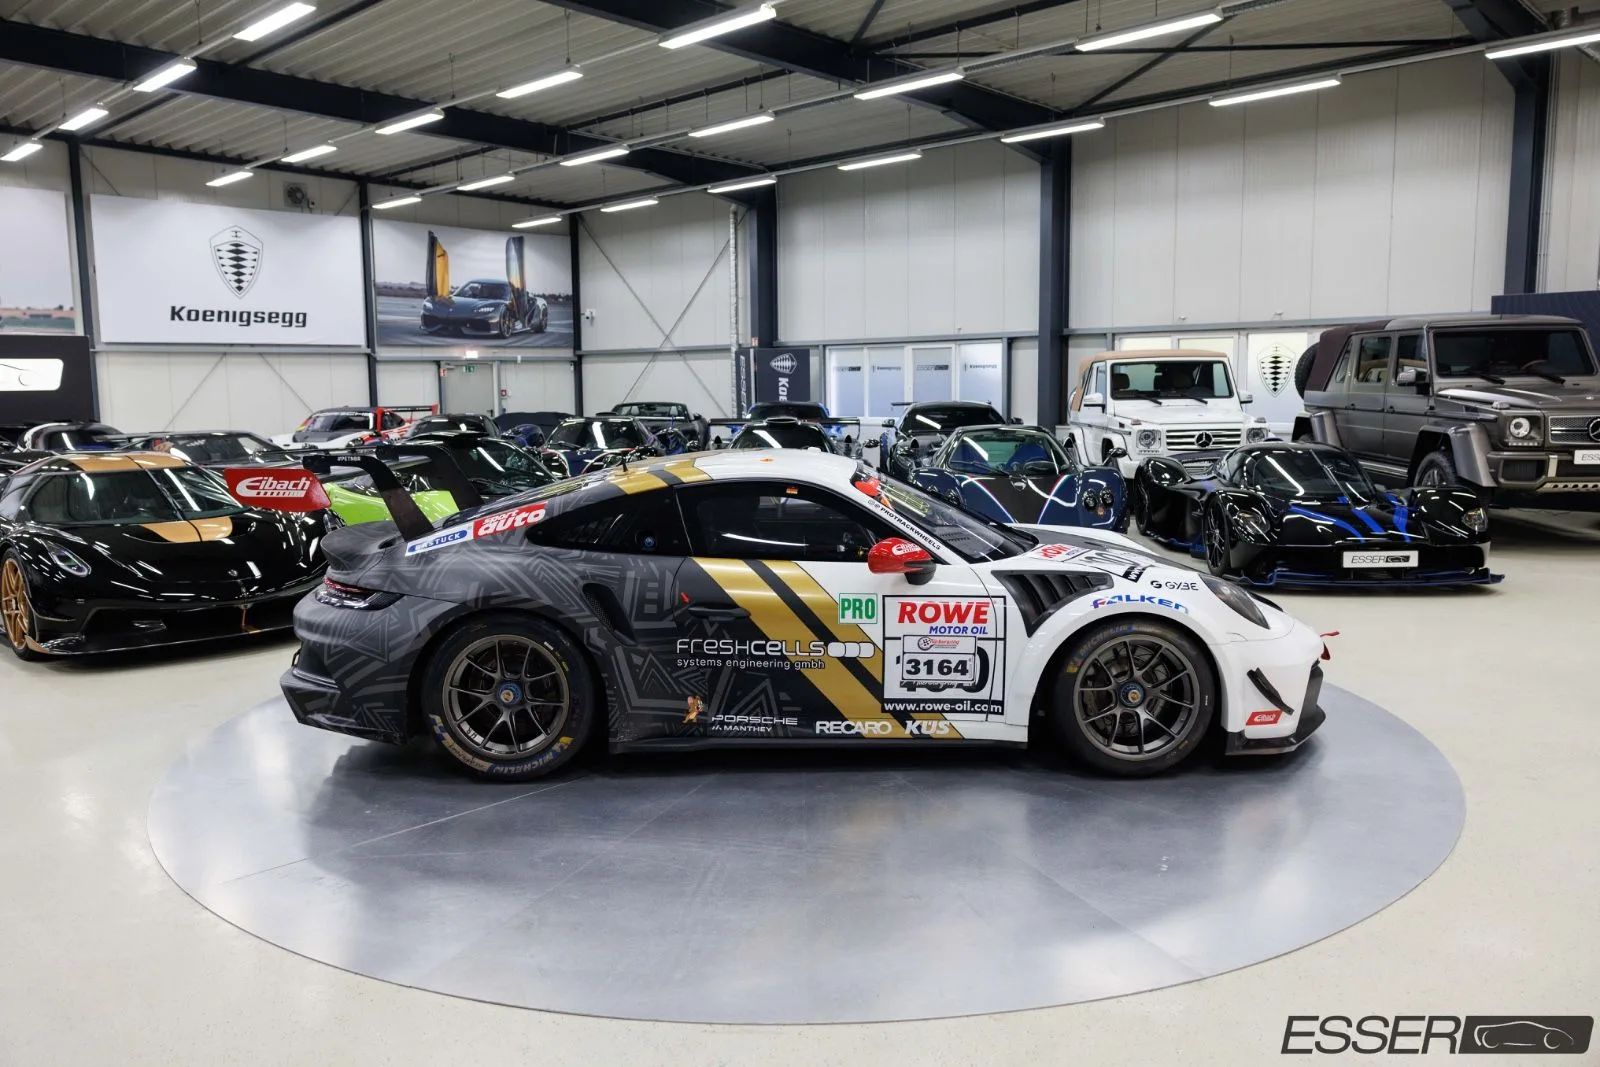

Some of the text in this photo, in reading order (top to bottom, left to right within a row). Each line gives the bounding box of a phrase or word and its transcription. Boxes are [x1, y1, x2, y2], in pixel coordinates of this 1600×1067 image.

[170, 305, 307, 328] Koenigsegg
[236, 477, 311, 497] Eibach
[478, 508, 546, 536] auto
[1351, 555, 1386, 564] ESSER
[840, 597, 876, 620] PRO
[898, 601, 990, 624] ROWE
[1092, 594, 1189, 615] FALKEN
[928, 626, 988, 635] MOTOR OIL
[677, 658, 825, 670] systems engineering gmbh
[905, 658, 969, 677] 3164
[884, 700, 1002, 713] www.rowe-oil.com
[711, 714, 798, 726] PORSCHE
[815, 720, 892, 735] RECARO
[904, 719, 950, 735] KÜS
